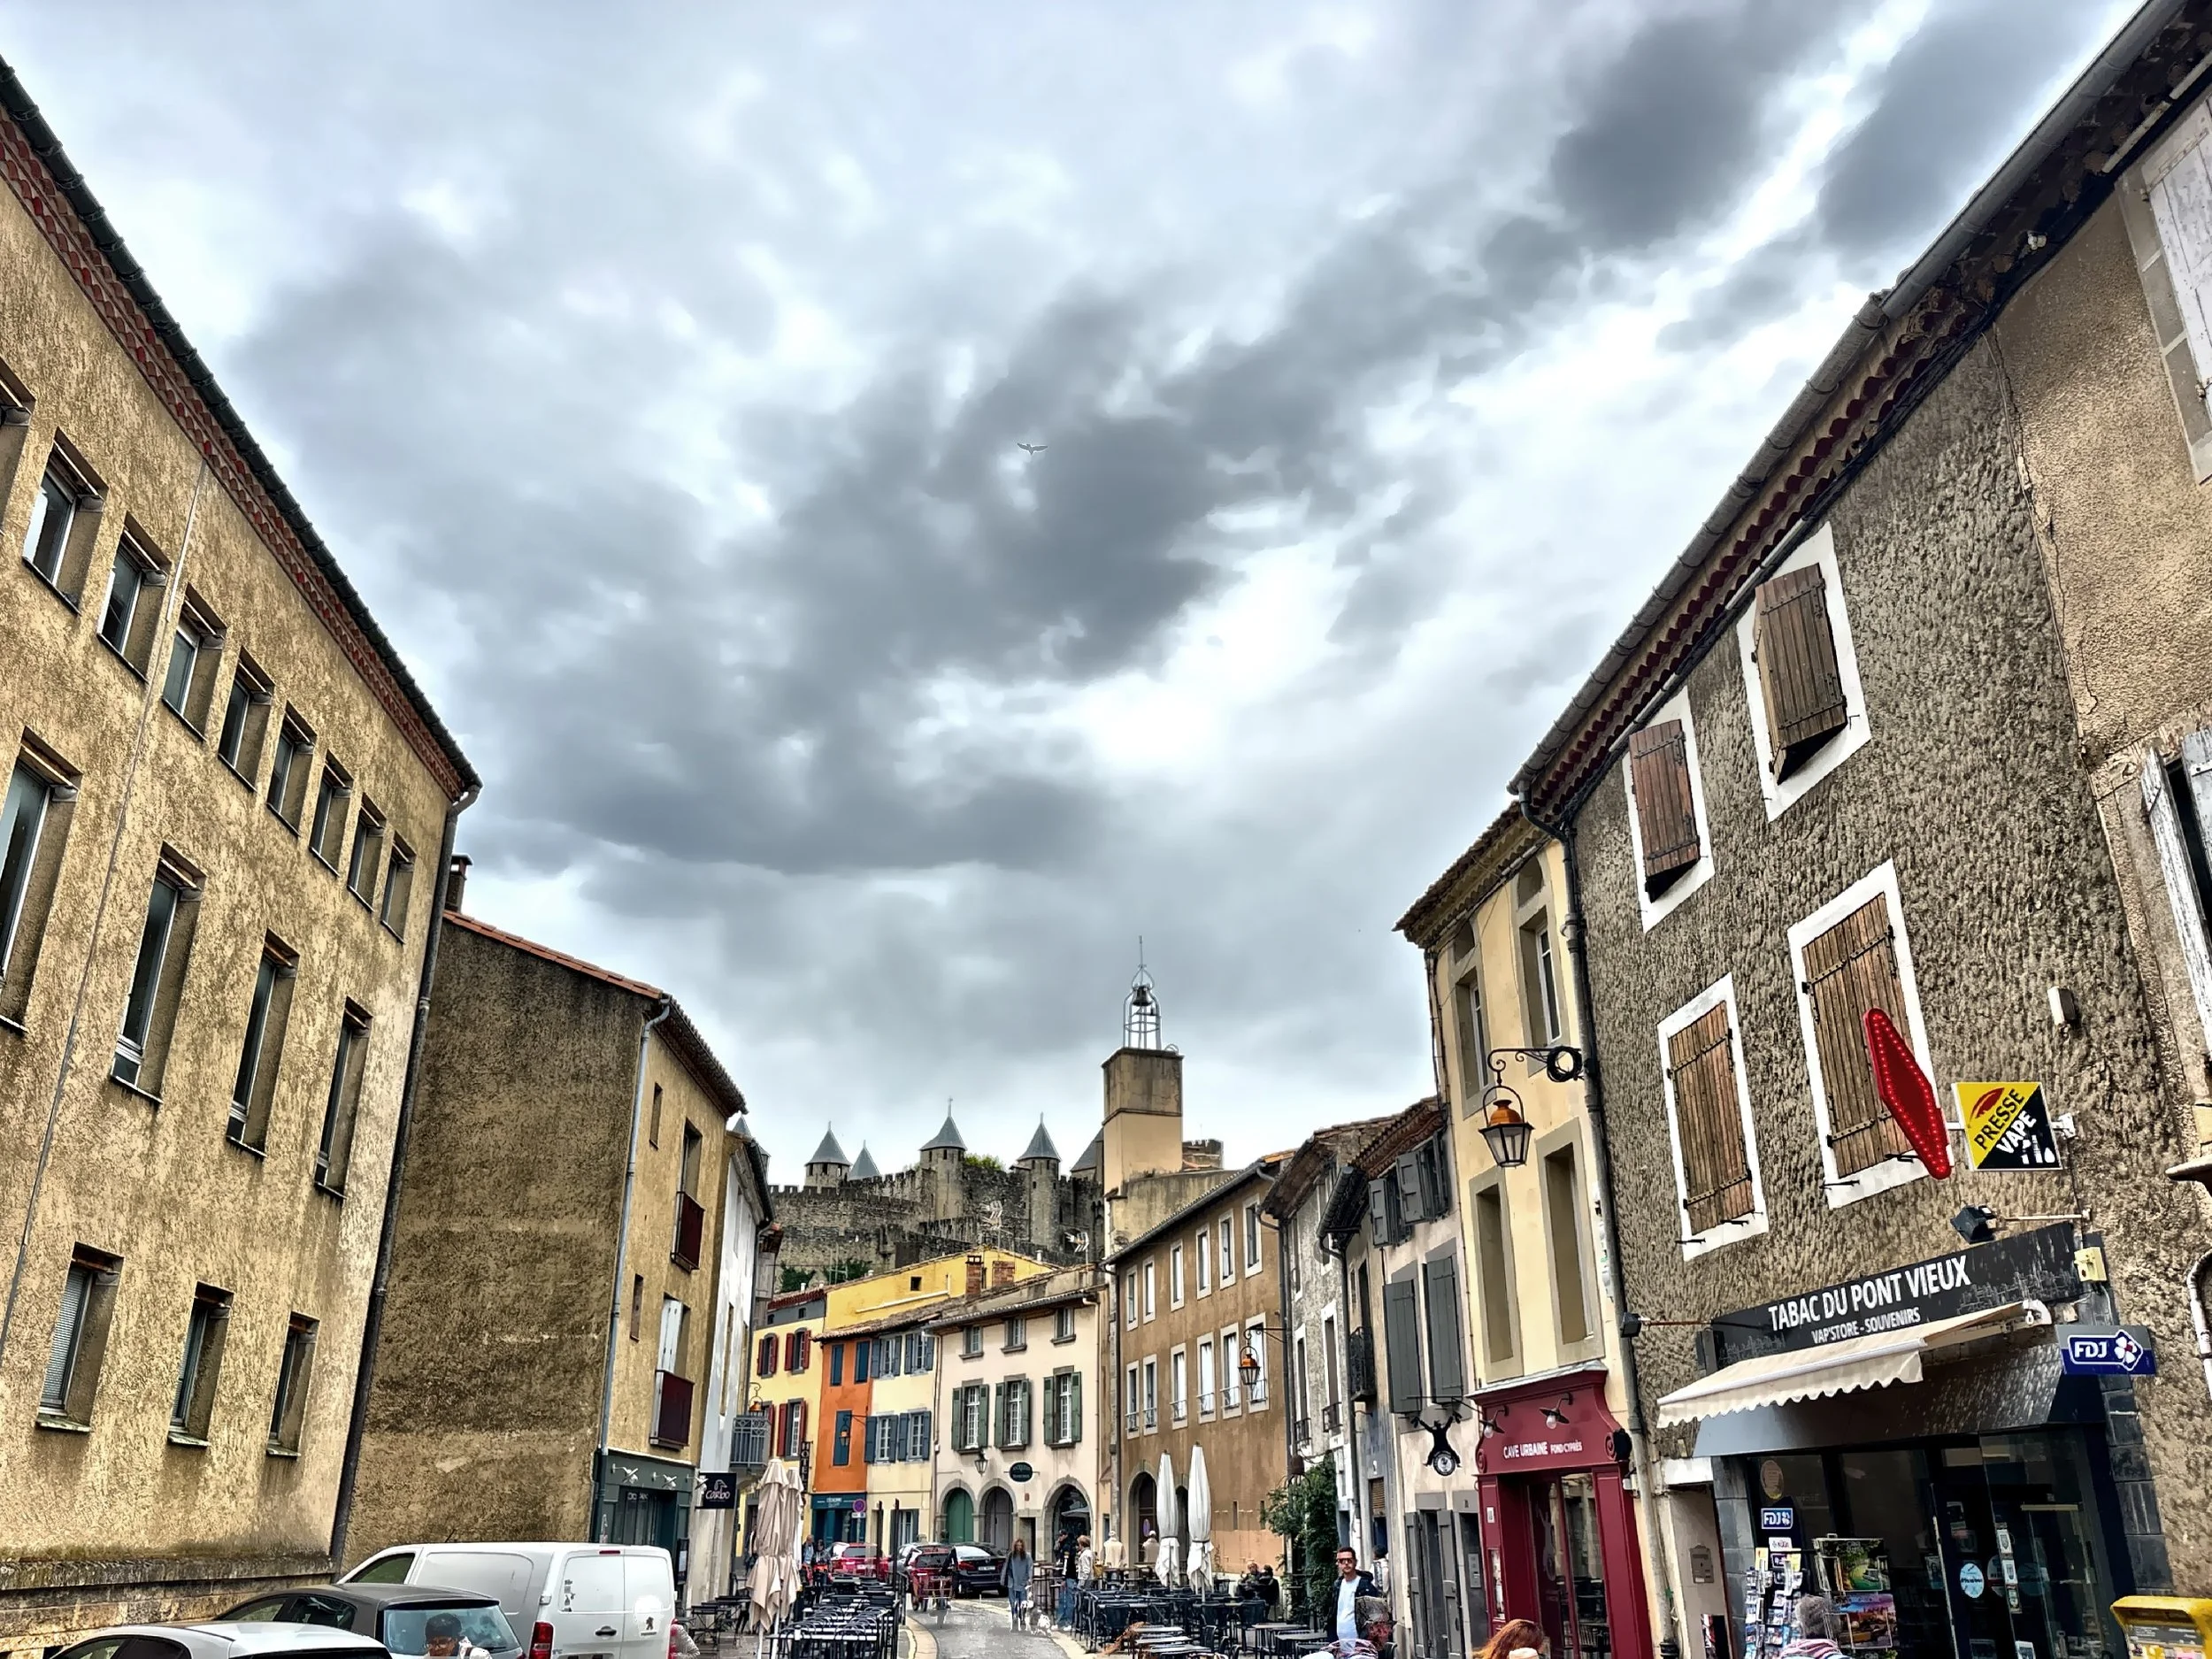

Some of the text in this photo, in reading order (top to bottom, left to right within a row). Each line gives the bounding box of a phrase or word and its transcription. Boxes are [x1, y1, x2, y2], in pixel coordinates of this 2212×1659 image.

[1974, 1088, 2024, 1149] PRESSE
[1996, 1110, 2037, 1153] VAPE
[1769, 1255, 1970, 1331] TABAC DU PONT VIEUX
[1811, 1321, 1859, 1343] VAP'STORE
[1865, 1307, 1921, 1333] SOUVENIRS
[2074, 1341, 2107, 1358] FDJ
[1503, 1445, 1519, 1458] CAVE
[1520, 1441, 1548, 1456] URBAINE
[1763, 1512, 1781, 1525] FDJ
